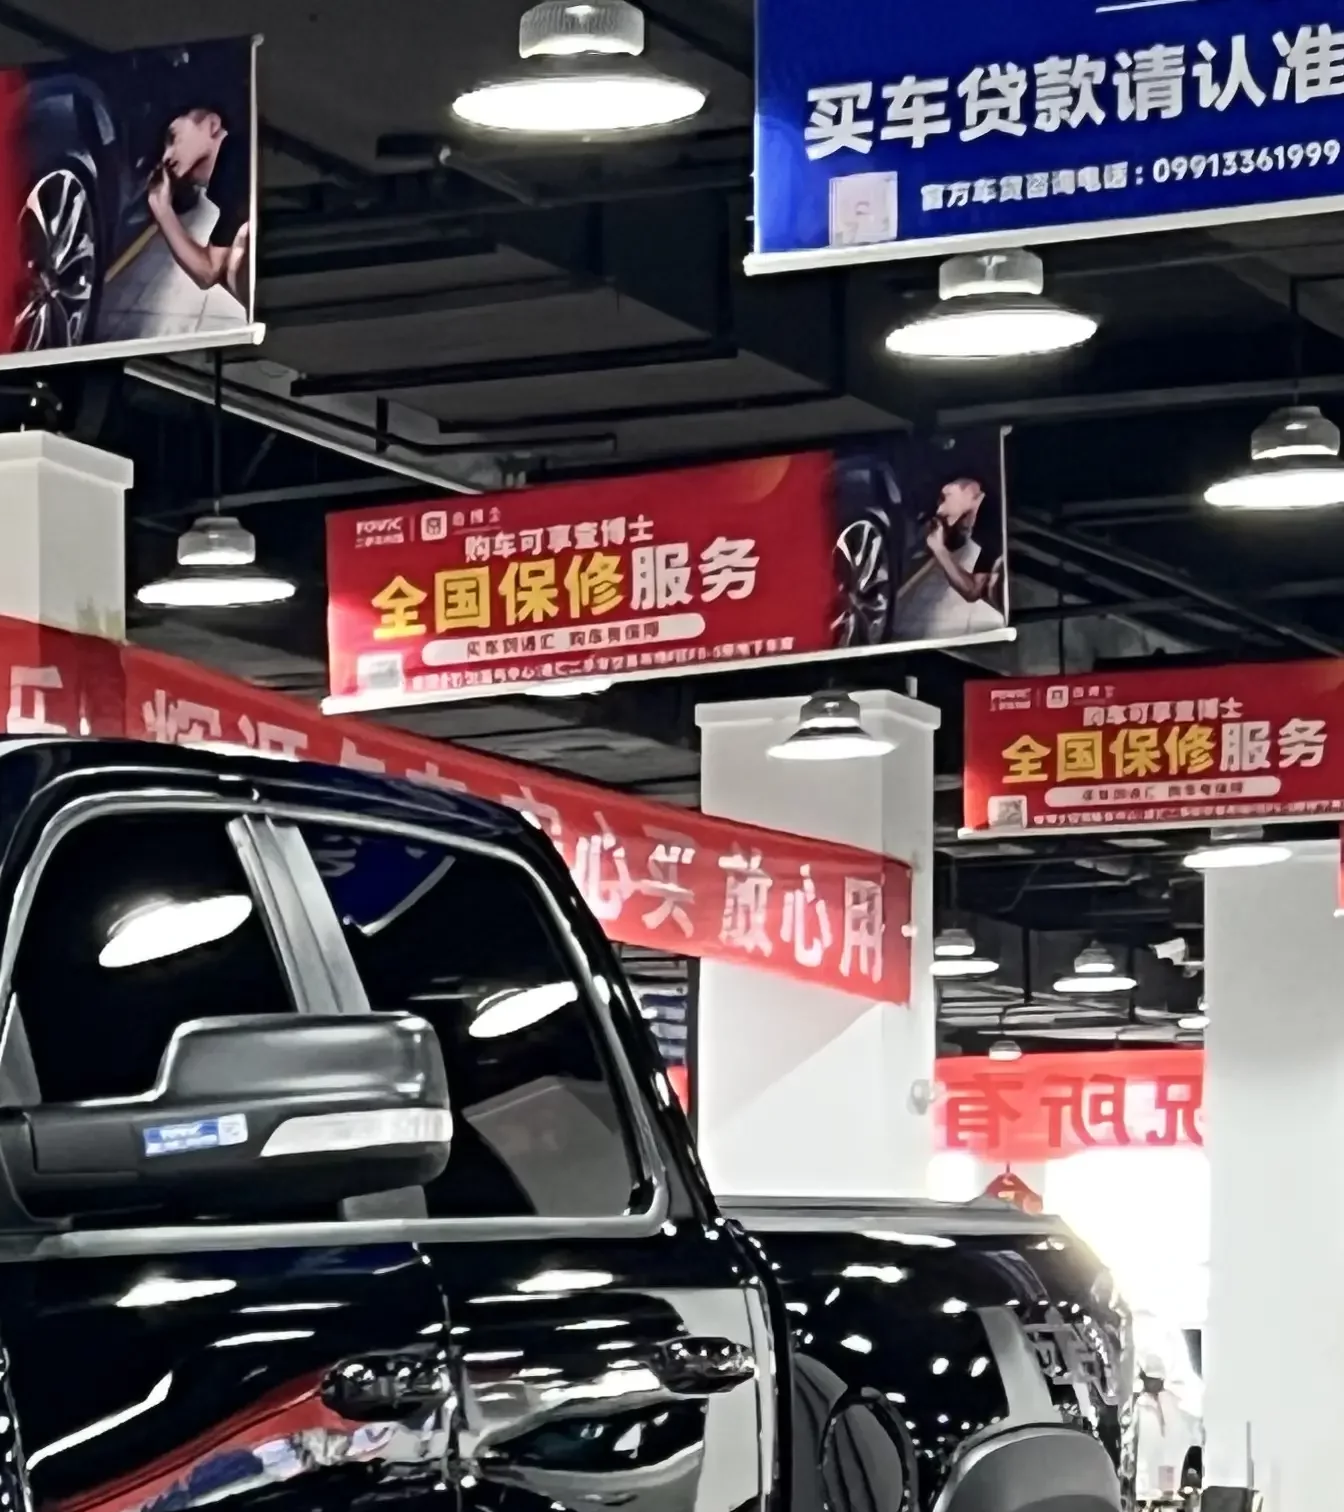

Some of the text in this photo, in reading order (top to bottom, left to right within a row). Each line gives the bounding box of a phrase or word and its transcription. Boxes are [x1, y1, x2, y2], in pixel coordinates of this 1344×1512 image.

[805, 23, 1344, 161] 买车贷款请认准
[372, 536, 761, 641] 全国保修服务
[1001, 718, 1328, 783] 全国保修服务
